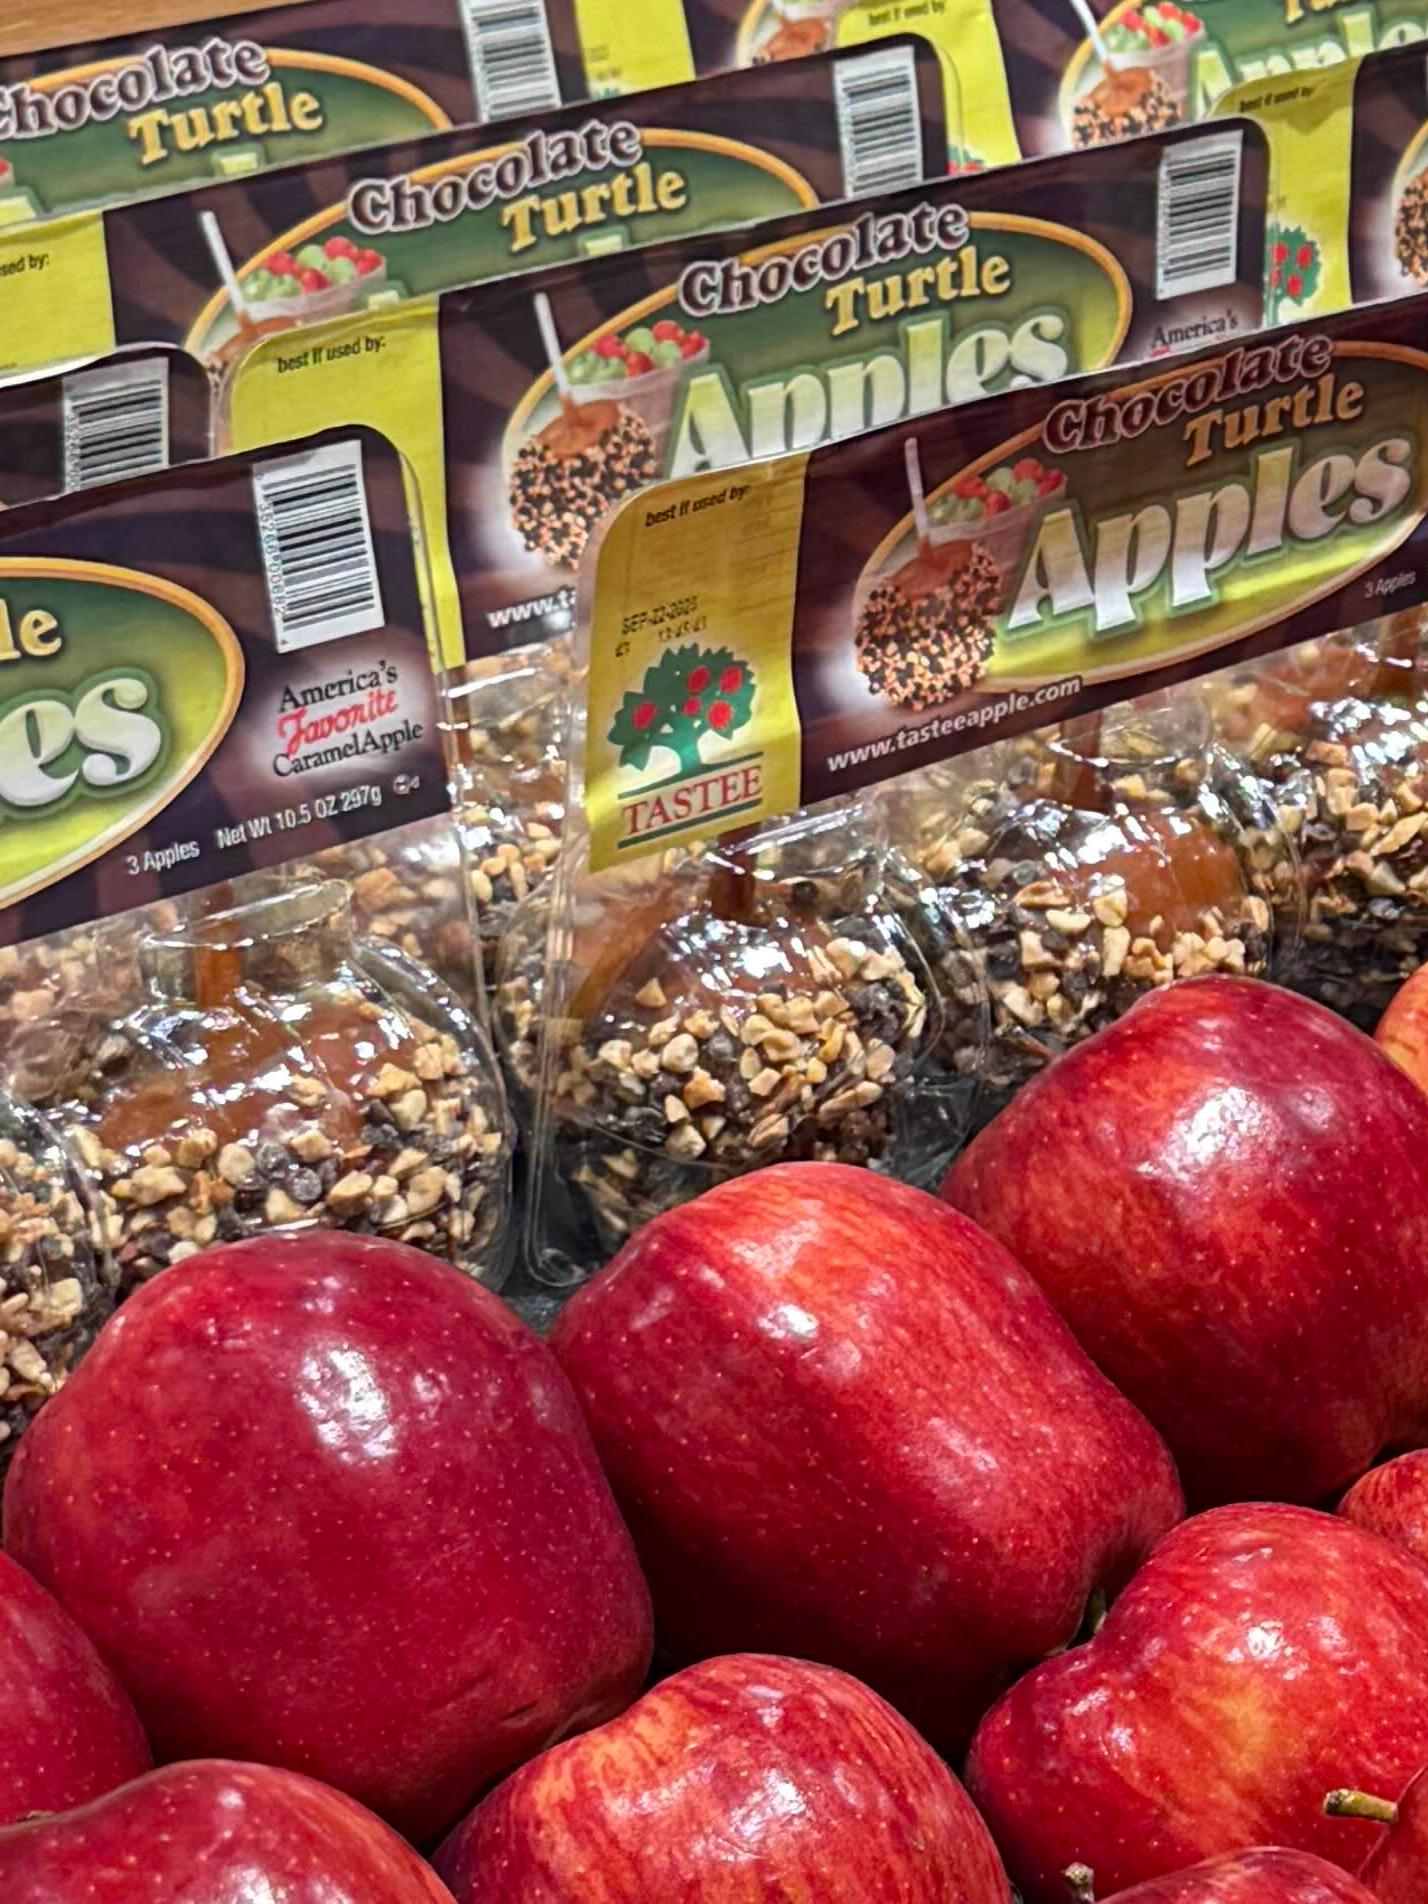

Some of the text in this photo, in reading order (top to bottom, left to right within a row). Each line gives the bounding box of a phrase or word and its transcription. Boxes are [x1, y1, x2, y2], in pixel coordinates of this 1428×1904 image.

[128, 82, 323, 166] Turtle
[350, 119, 643, 235] Chocolate
[502, 162, 686, 252] Turtle
[29, 251, 50, 271] by:
[678, 202, 969, 317] Chocolate
[824, 245, 1011, 337] Turtle
[278, 336, 387, 374] best if used by:
[1150, 309, 1239, 347] America's
[1043, 334, 1334, 454] Chocolate
[1183, 374, 1364, 467] Turtle
[645, 504, 677, 527] best
[679, 499, 691, 517] if
[692, 489, 727, 512] used
[1007, 438, 1412, 632] Apples
[1364, 580, 1374, 598] 3
[1375, 571, 1416, 596] Apples
[277, 689, 398, 759] Favorite
[278, 660, 398, 713] America's
[826, 675, 1083, 773] www.tasteeapple.com
[126, 784, 383, 876] 3 Apples Net Wt 10.5 OZ 297g
[622, 765, 763, 836] TASTEE
